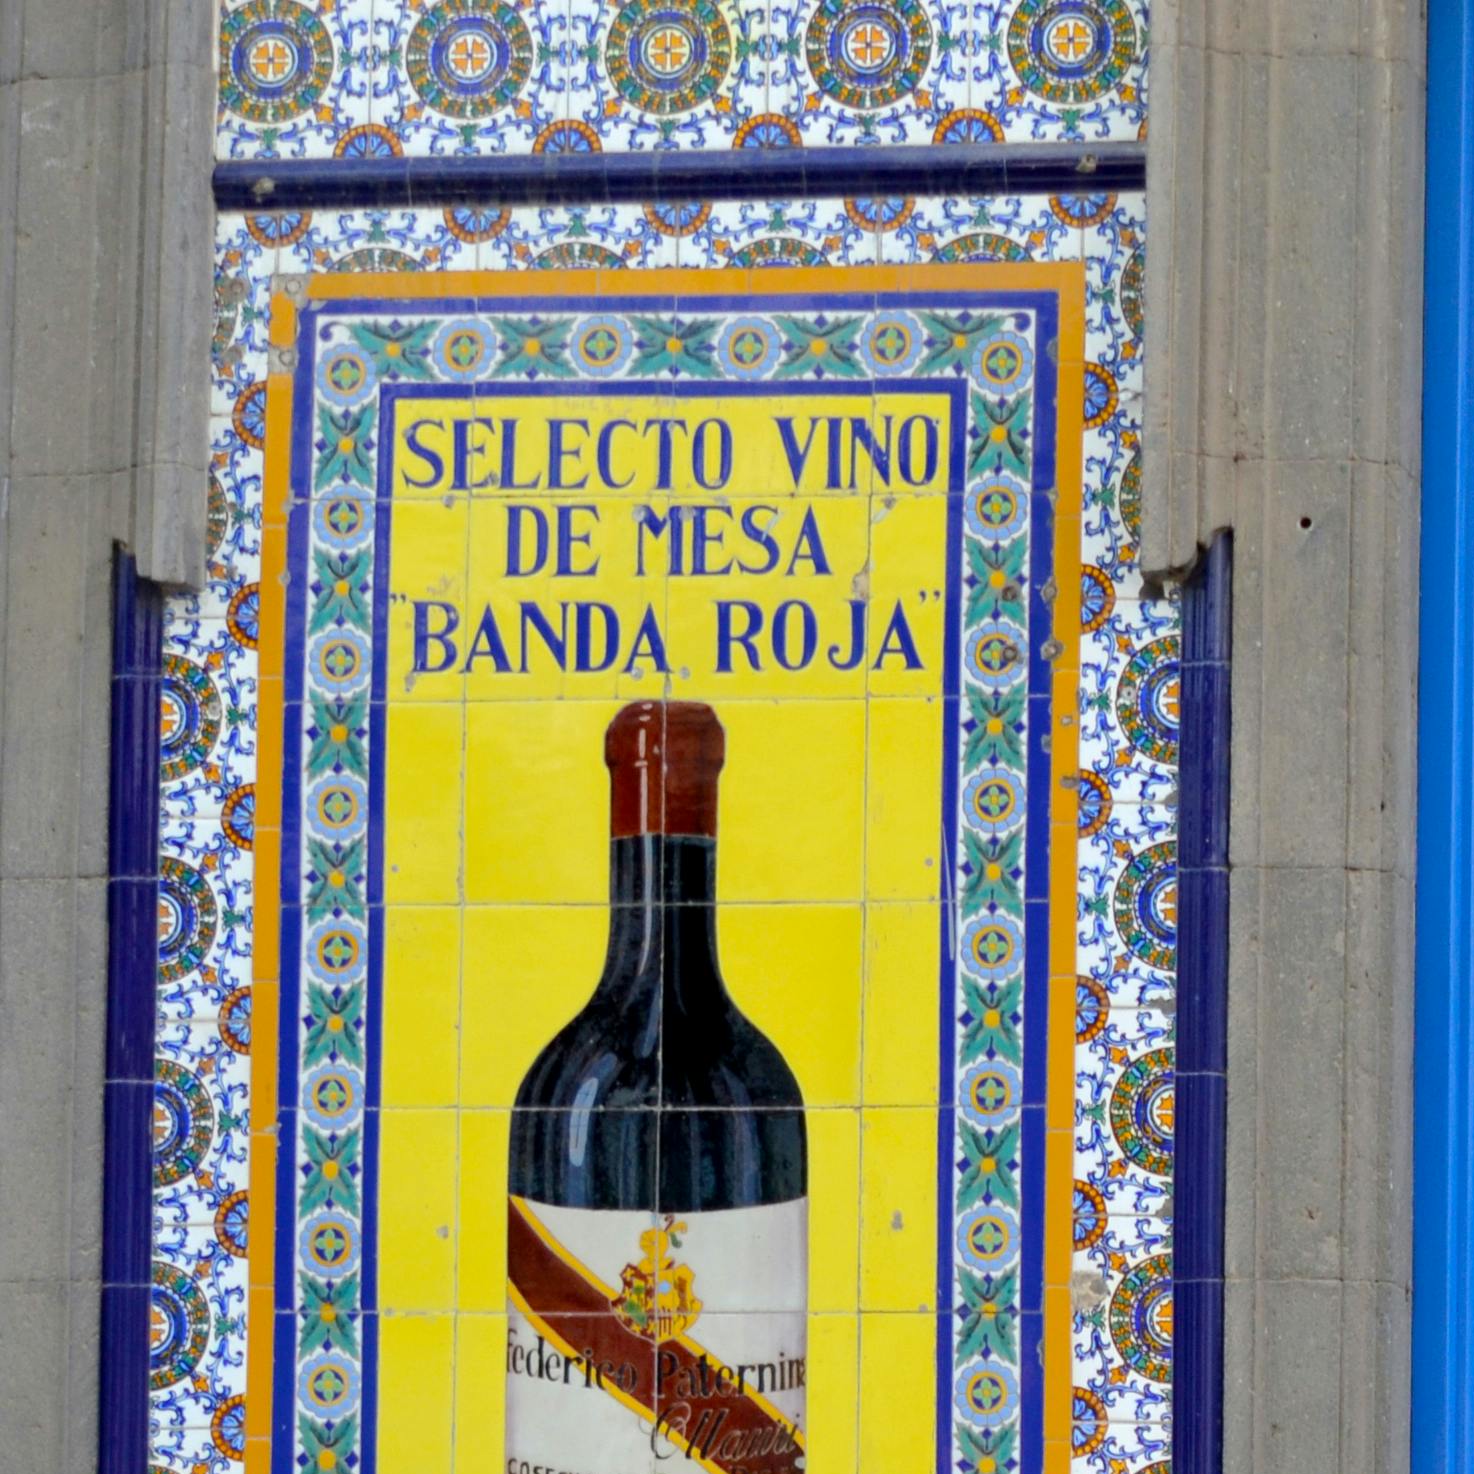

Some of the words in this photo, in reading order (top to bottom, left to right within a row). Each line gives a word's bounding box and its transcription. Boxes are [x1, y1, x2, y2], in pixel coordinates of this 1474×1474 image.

[403, 416, 733, 490] SELECTO
[772, 415, 940, 489] VINO
[505, 505, 600, 578] DE
[637, 505, 833, 577] MESA
[656, 1348, 806, 1399] Paternin
